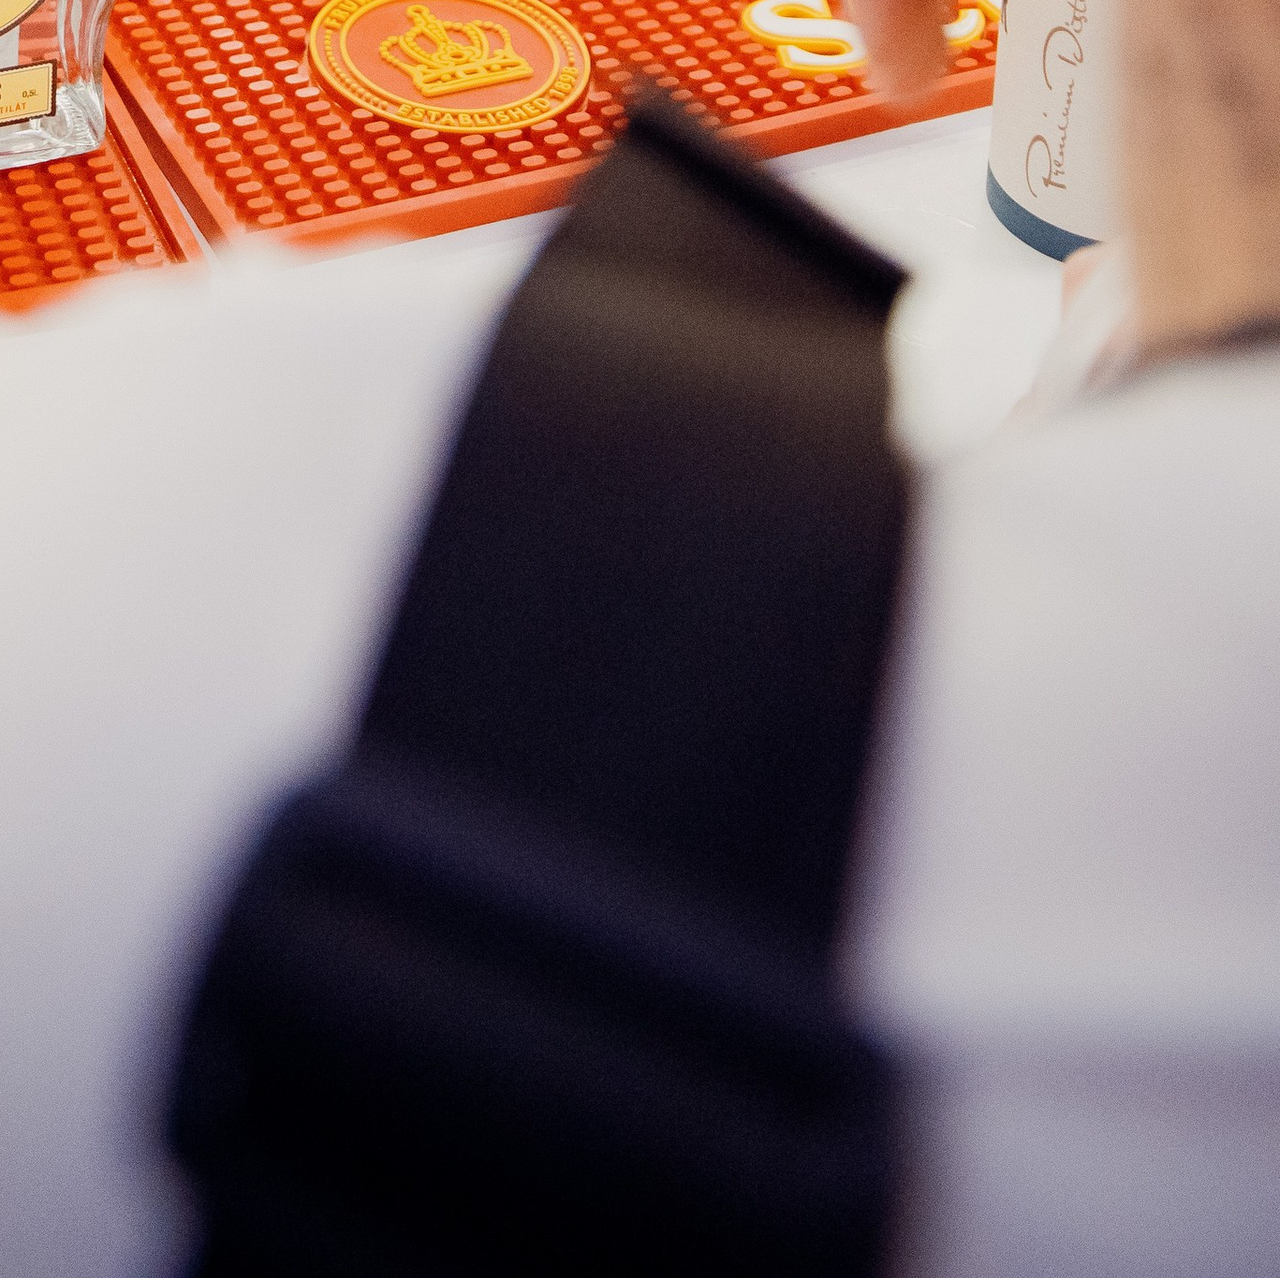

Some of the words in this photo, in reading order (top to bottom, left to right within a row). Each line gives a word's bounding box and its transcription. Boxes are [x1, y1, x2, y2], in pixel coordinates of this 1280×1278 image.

[397, 97, 552, 127] ESTABLISHED
[549, 65, 580, 104] 1898
[1025, 79, 1075, 199] Premium
